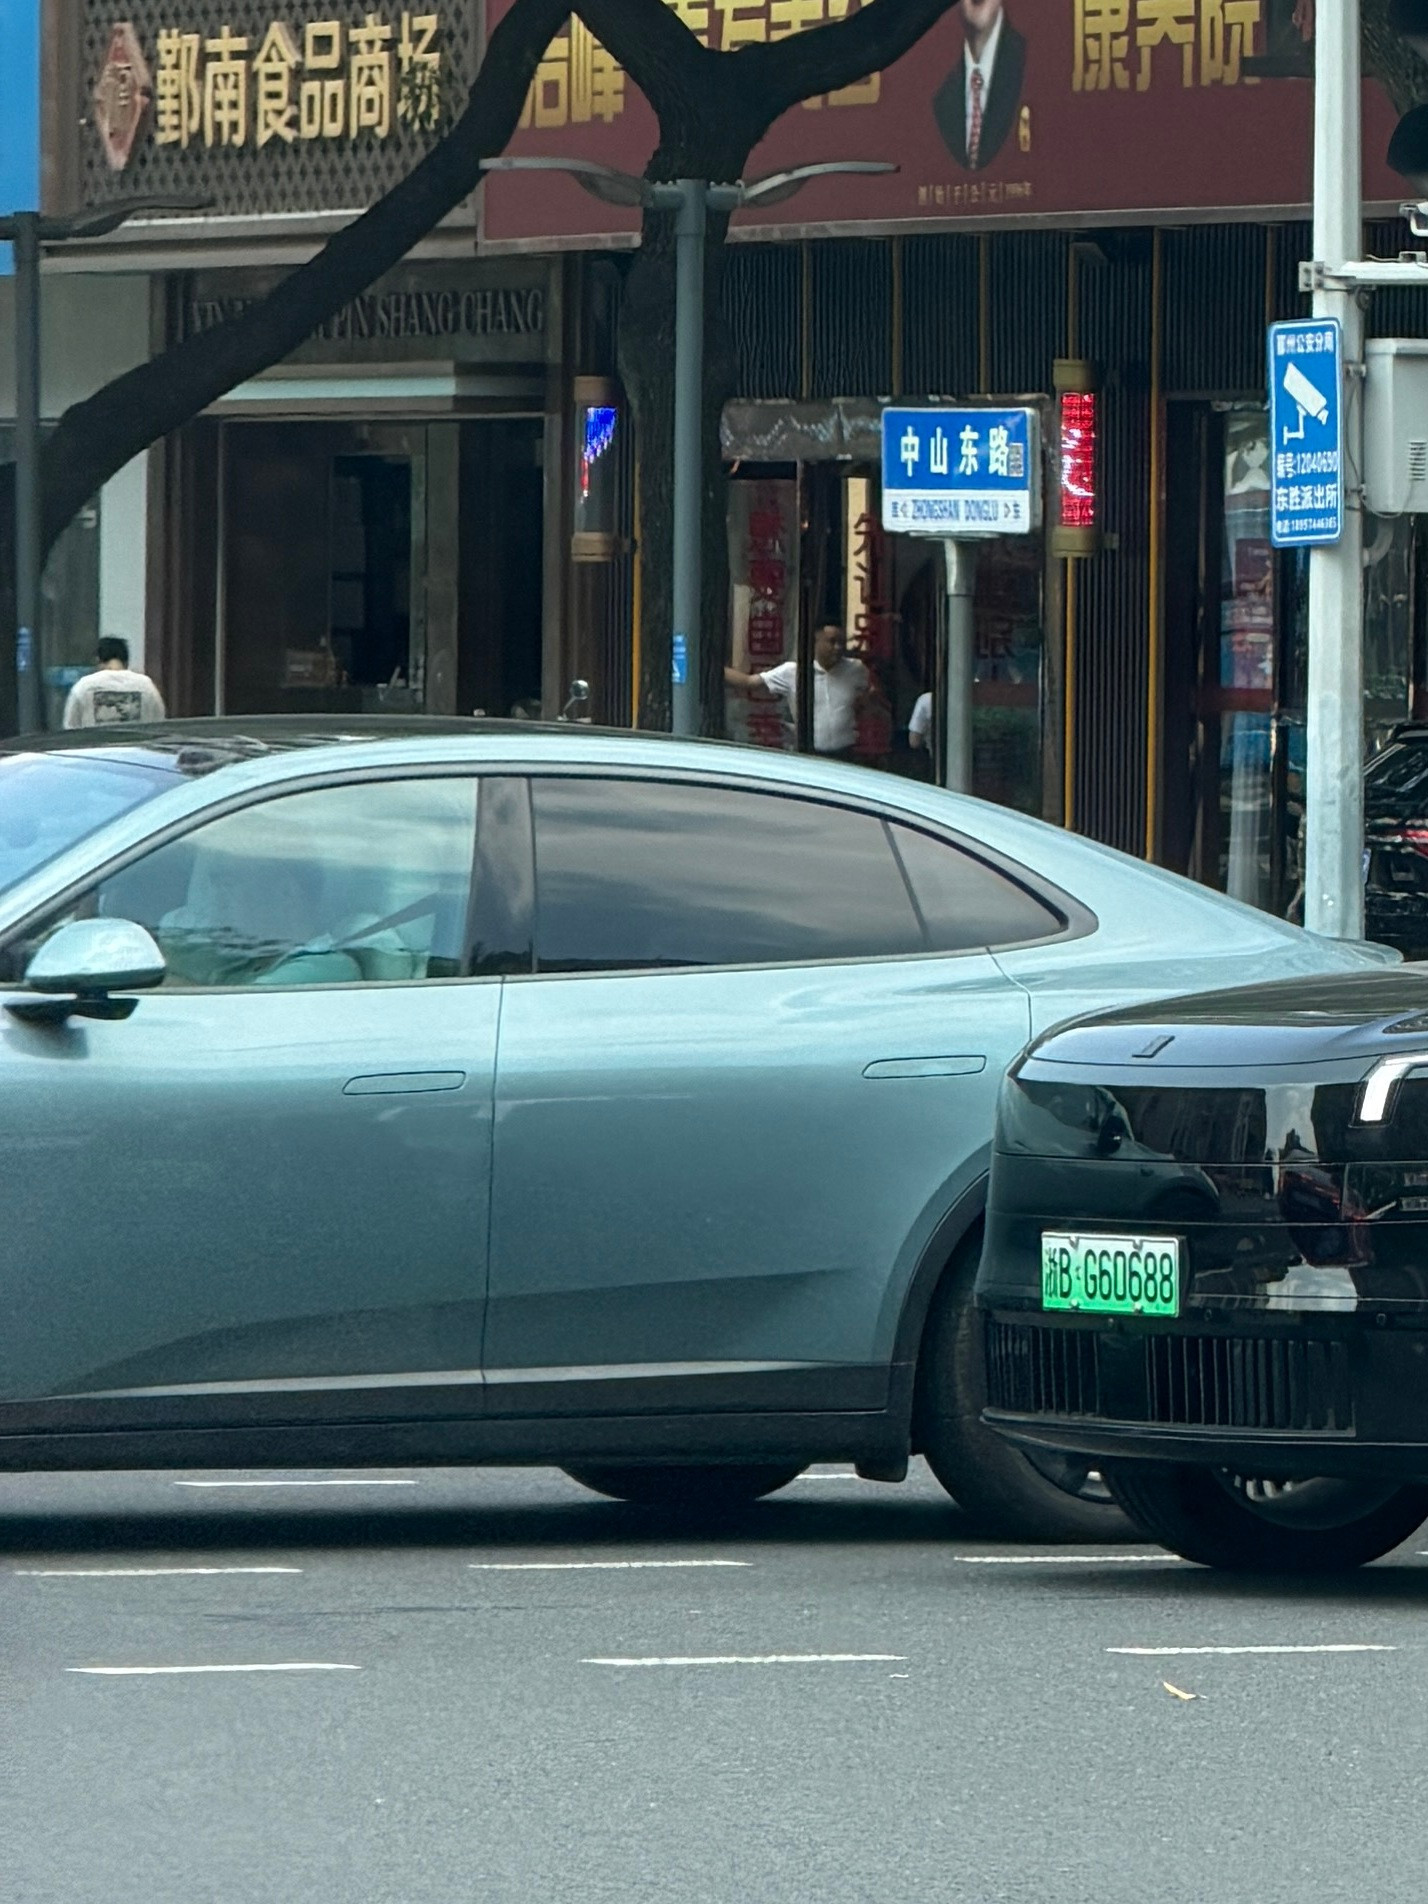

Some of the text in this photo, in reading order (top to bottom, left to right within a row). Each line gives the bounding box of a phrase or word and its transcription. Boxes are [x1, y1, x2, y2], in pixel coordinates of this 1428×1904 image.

[155, 12, 441, 149] 鄞南食品商场
[376, 292, 454, 337] SHANG
[458, 288, 544, 333] CHANG
[900, 424, 1009, 478] 中山东路
